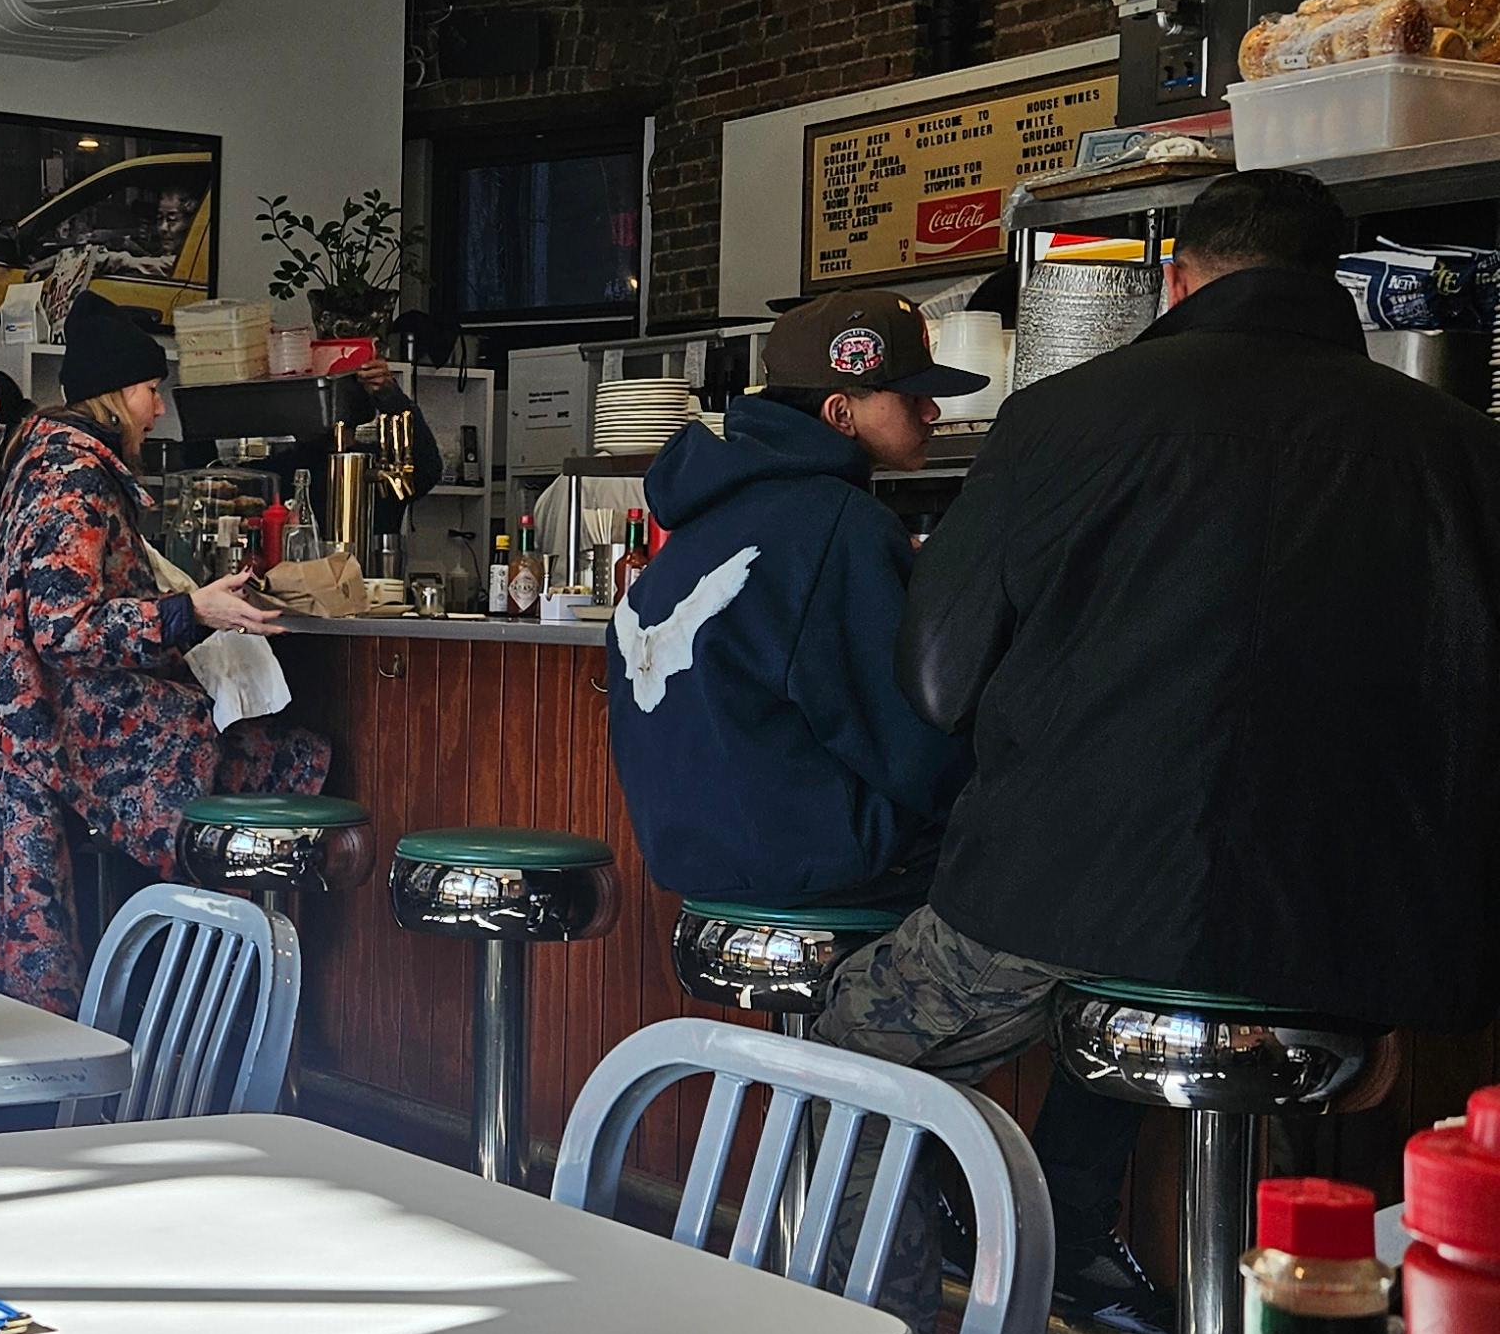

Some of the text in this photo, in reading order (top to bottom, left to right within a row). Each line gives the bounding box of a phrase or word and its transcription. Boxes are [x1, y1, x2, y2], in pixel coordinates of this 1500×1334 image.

[1027, 89, 1100, 113] HOUSE WINES
[918, 110, 989, 133] WELCOME TO
[1016, 114, 1054, 131] WHITE
[830, 139, 858, 153] DRAFT
[867, 132, 890, 146] BEER
[916, 124, 993, 148] GOLDEN DINER
[824, 146, 882, 166] GOLDEN ALE
[1022, 139, 1074, 158] MUSCADET
[824, 162, 866, 178] FLAGSHIP
[828, 164, 906, 187] ITALIA PILSNER
[924, 161, 982, 181] THANKS FOR
[1016, 157, 1063, 175] ORANGE
[822, 182, 879, 201] SLOOP JUICE
[924, 174, 982, 194] STOPPING BY
[854, 195, 868, 206] IPA
[856, 202, 893, 217] BREWING
[829, 215, 878, 231] RICE LAGER
[899, 238, 909, 250] 10
[820, 251, 907, 273] TECATE 5
